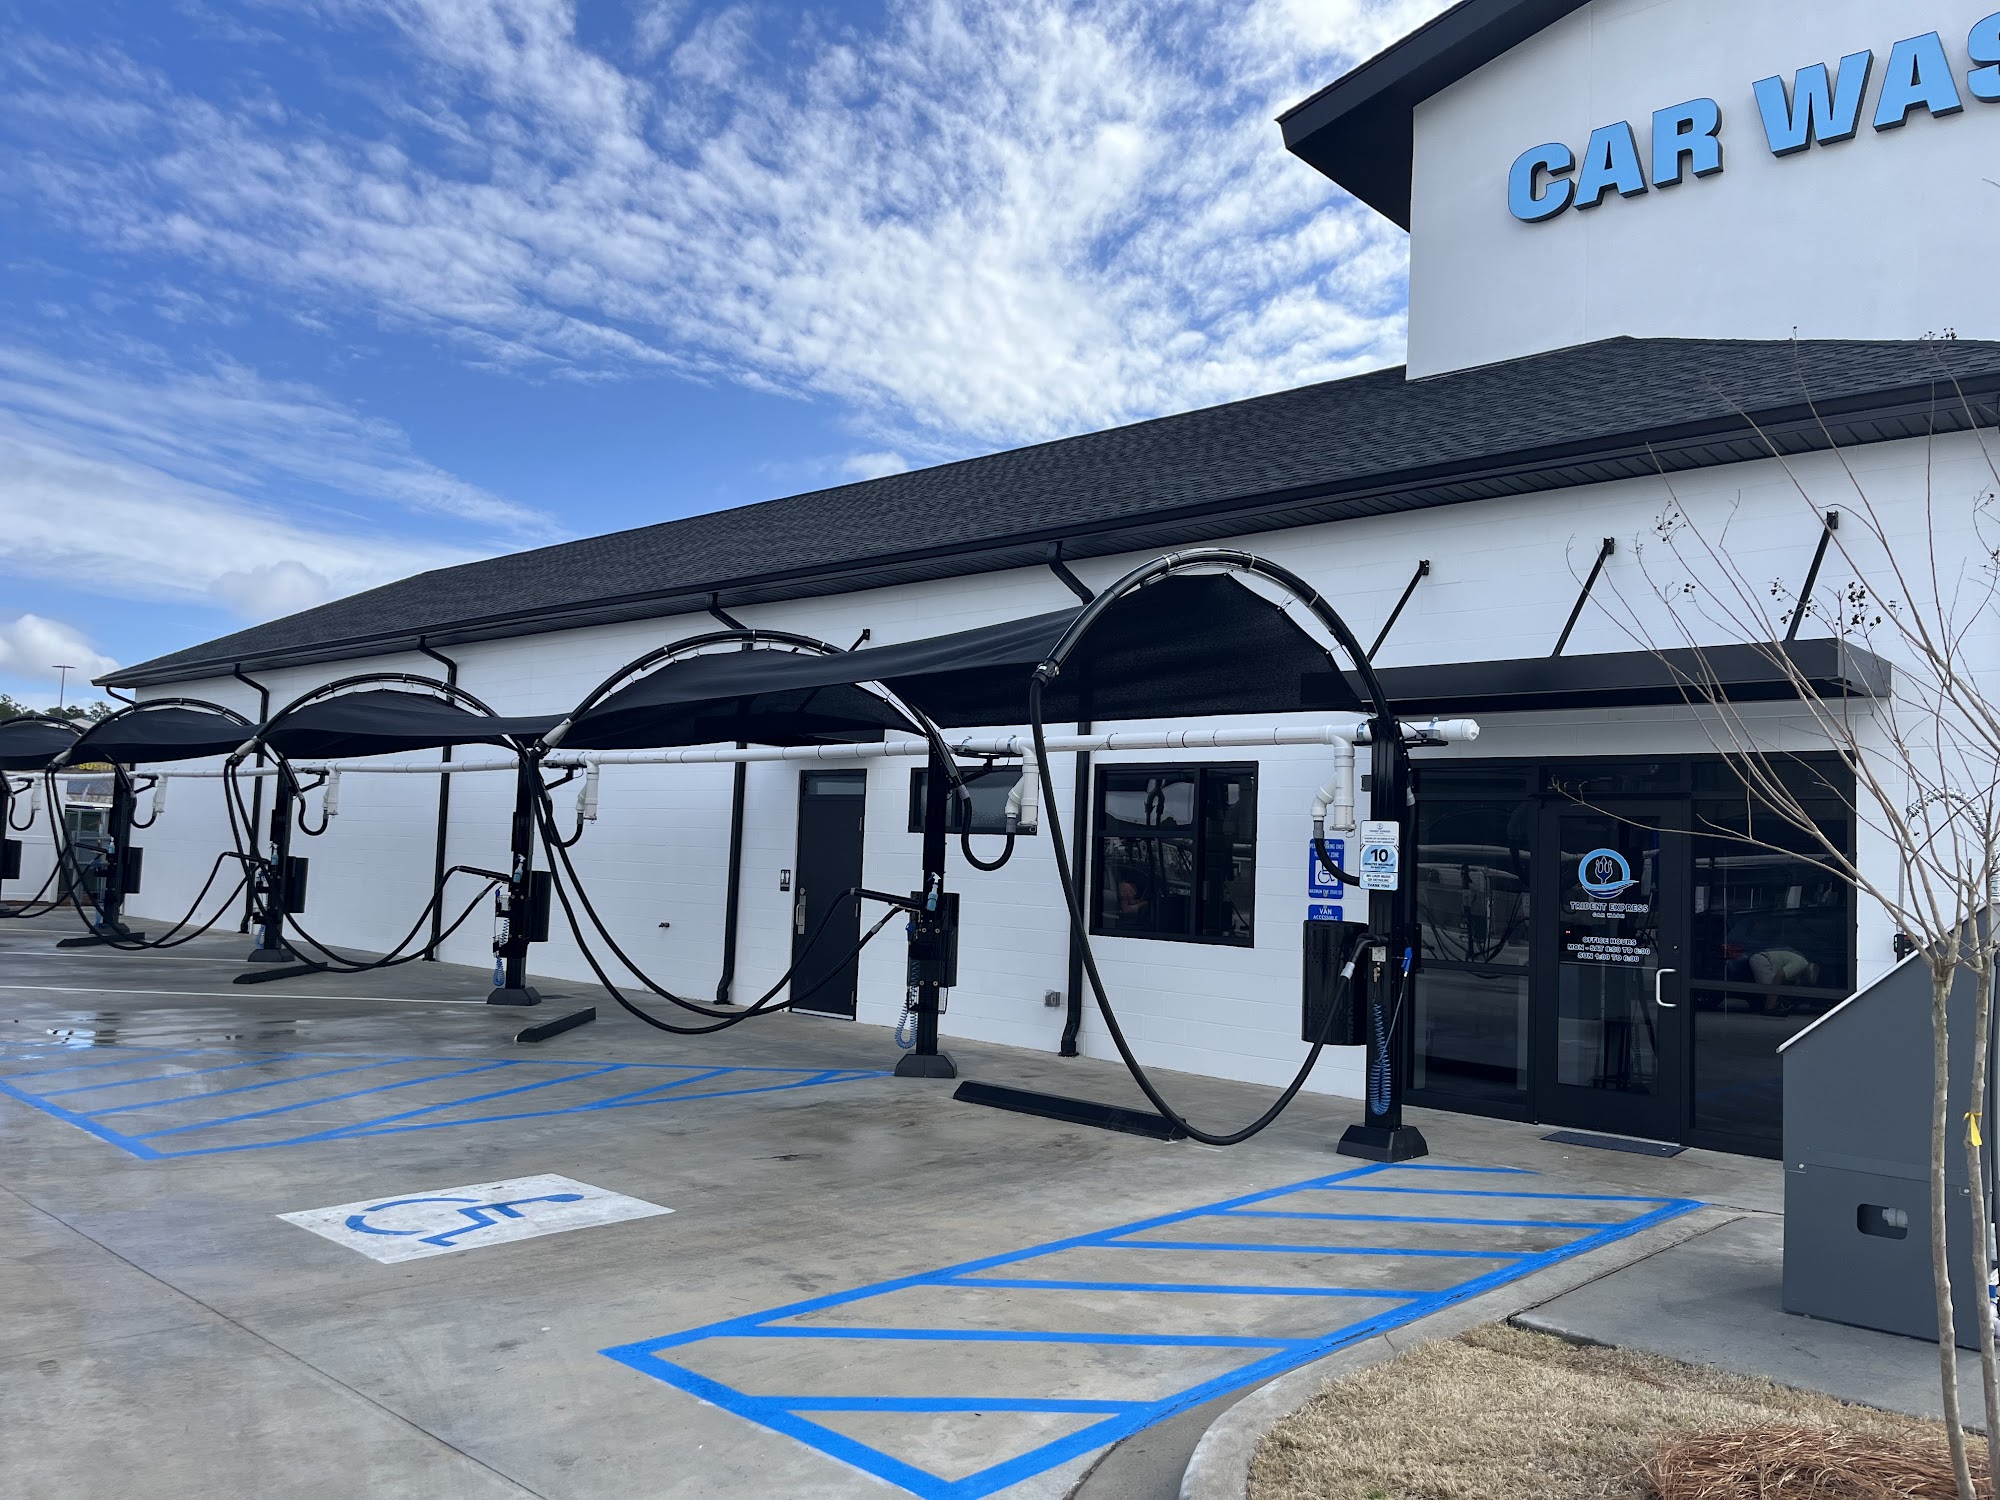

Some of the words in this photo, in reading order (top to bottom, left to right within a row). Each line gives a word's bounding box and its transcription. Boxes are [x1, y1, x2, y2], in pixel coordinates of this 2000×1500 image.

[1508, 97, 1723, 223] CAR
[79, 762, 112, 770] SUSHI
[1370, 848, 1388, 862] 10
[1570, 901, 1607, 911] TRIDENT
[1609, 903, 1649, 913] EXPRESS
[1582, 936, 1609, 944] OFFICE
